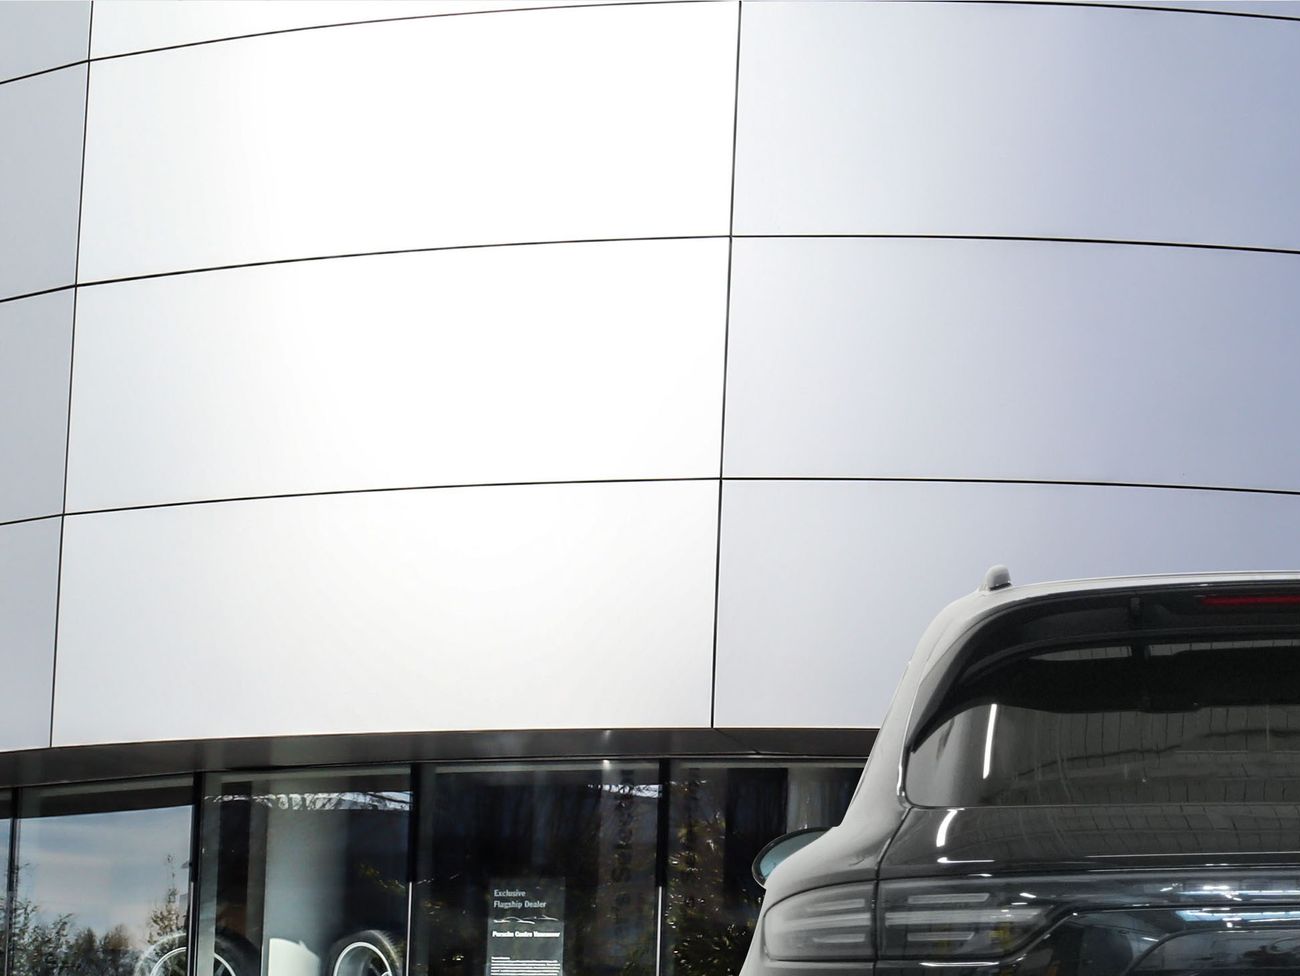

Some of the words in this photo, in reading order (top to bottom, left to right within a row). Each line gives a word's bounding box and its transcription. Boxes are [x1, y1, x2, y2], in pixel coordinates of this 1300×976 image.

[493, 889, 526, 897] Exclusive
[493, 900, 523, 909] Flagship
[524, 900, 547, 908] Dealer
